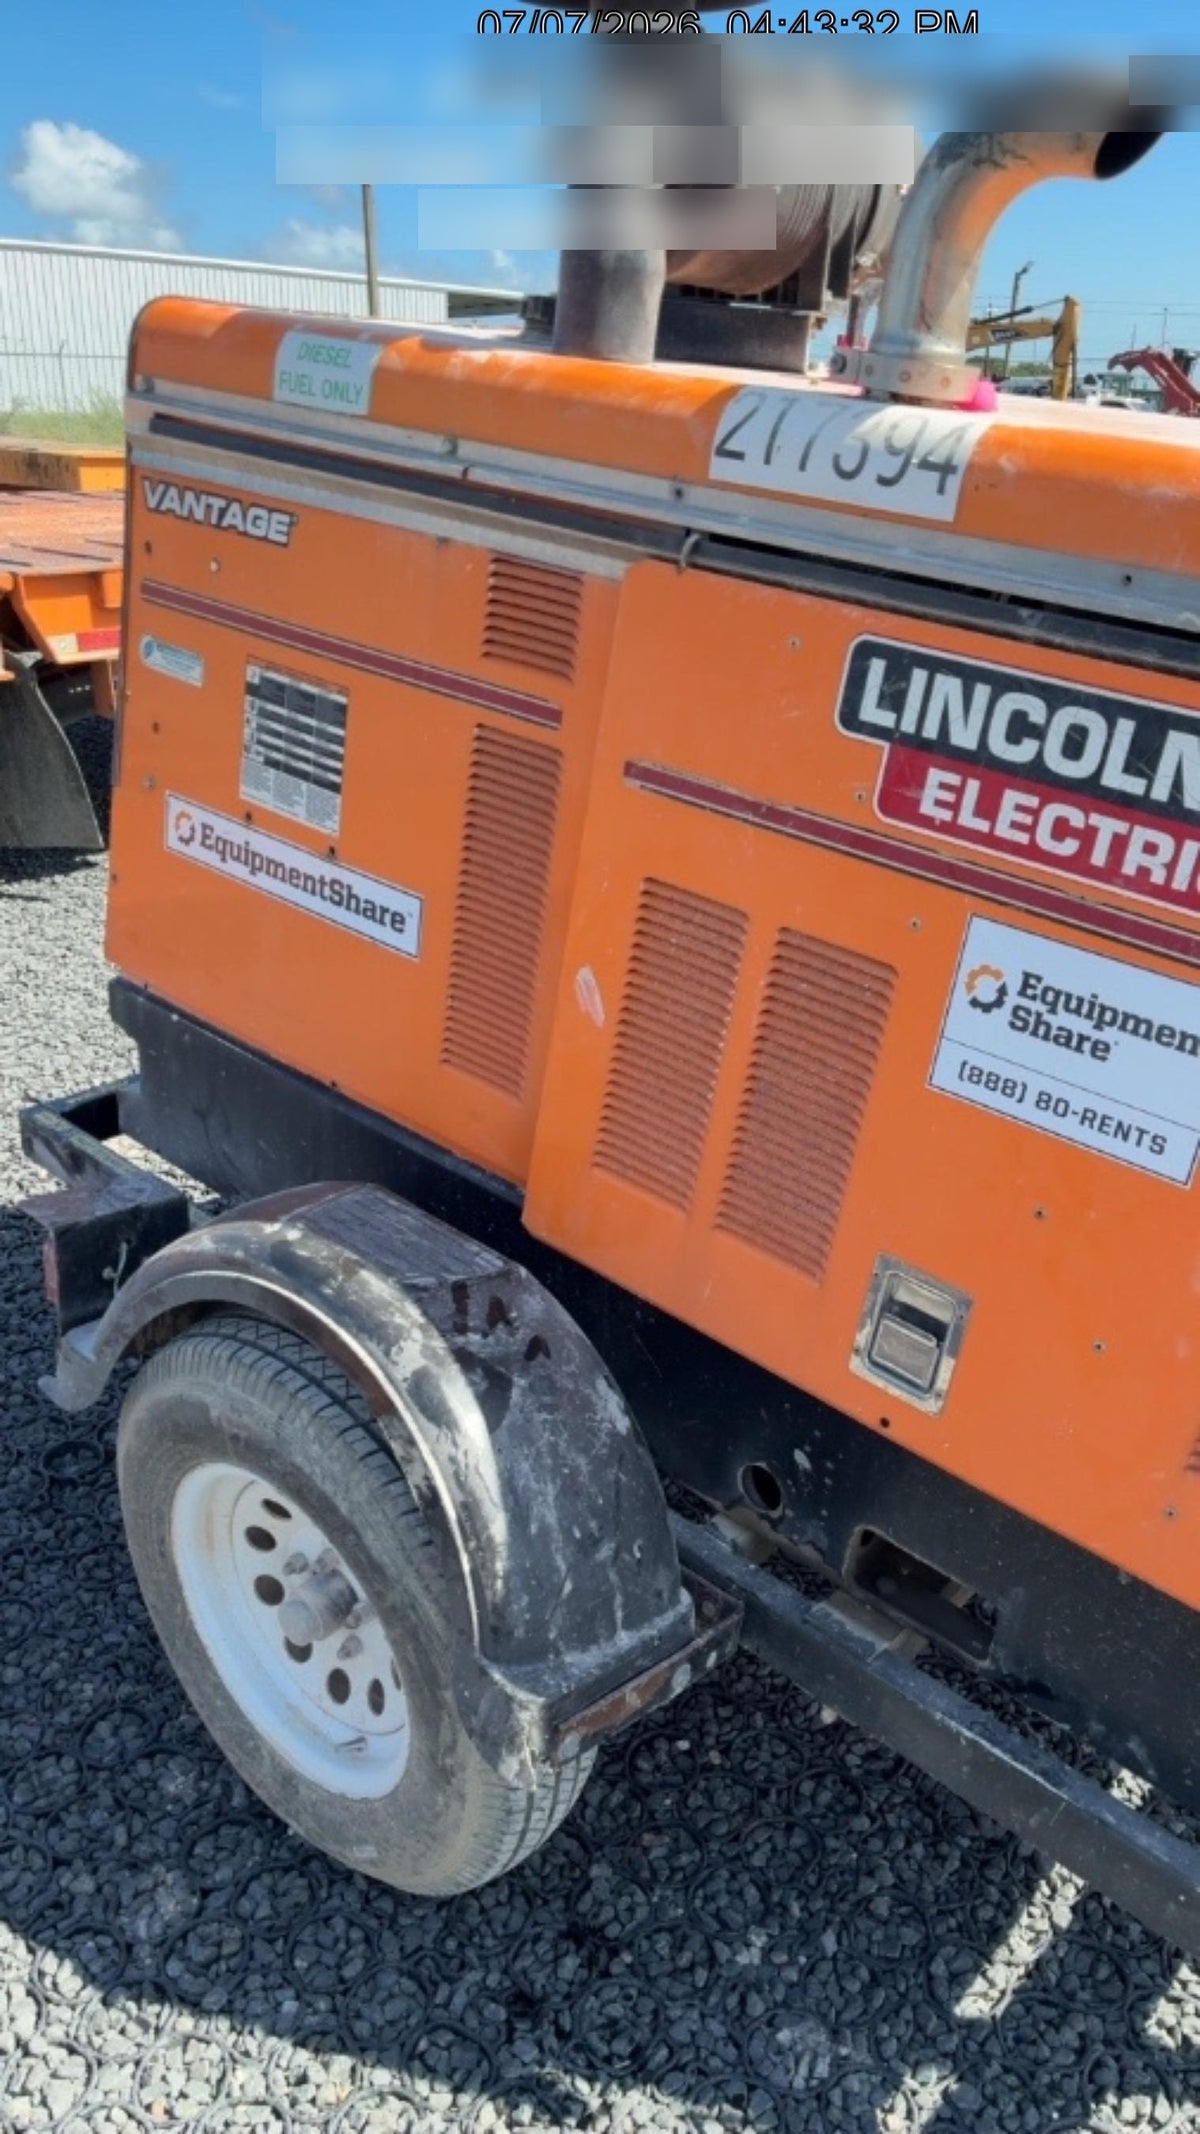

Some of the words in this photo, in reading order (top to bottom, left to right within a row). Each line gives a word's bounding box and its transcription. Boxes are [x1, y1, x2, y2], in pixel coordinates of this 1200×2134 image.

[279, 369, 316, 397] FUEL
[322, 379, 363, 405] ONLY
[296, 341, 352, 368] DIESEL
[143, 479, 291, 544] VANTAGE
[919, 767, 1200, 894] ELECTRI
[200, 822, 406, 935] EquipmentShare
[1008, 1004, 1113, 1063] Share
[1017, 970, 1200, 1057] Equipmen
[957, 1059, 1029, 1104] (888)
[1035, 1090, 1168, 1156] 80-RENTS
